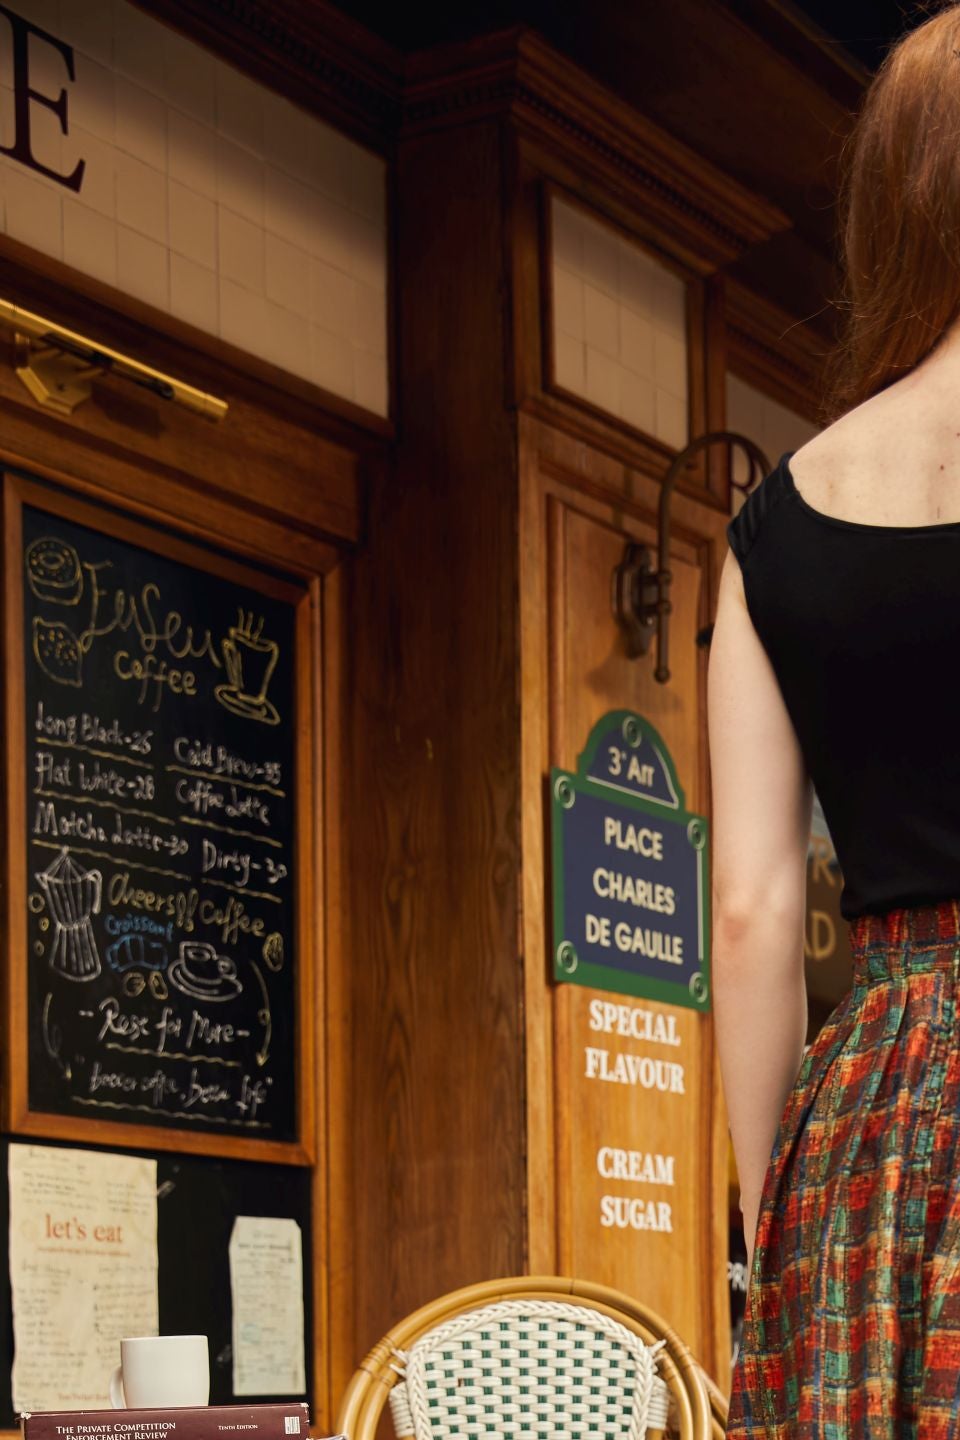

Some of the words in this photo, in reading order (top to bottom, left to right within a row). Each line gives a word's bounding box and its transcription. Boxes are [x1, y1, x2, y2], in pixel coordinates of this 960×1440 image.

[36, 701, 77, 745] Long
[35, 752, 72, 791] Flat
[33, 801, 107, 842] Matcha
[604, 816, 664, 861] PLACE
[593, 867, 676, 916] CHARLES
[585, 913, 611, 947] DE
[614, 922, 684, 965] GAULLE
[589, 999, 681, 1047] SPECIAL
[585, 1047, 685, 1094] FLAVOUR
[597, 1146, 675, 1186] CREAM
[45, 1213, 87, 1240] let's
[93, 1225, 122, 1244] eat
[600, 1195, 673, 1233] SUGAR
[56, 1425, 74, 1434] THE
[77, 1424, 112, 1433] PRIVATE
[113, 1422, 176, 1432] COMPETITION
[134, 1431, 168, 1440] REVIEW
